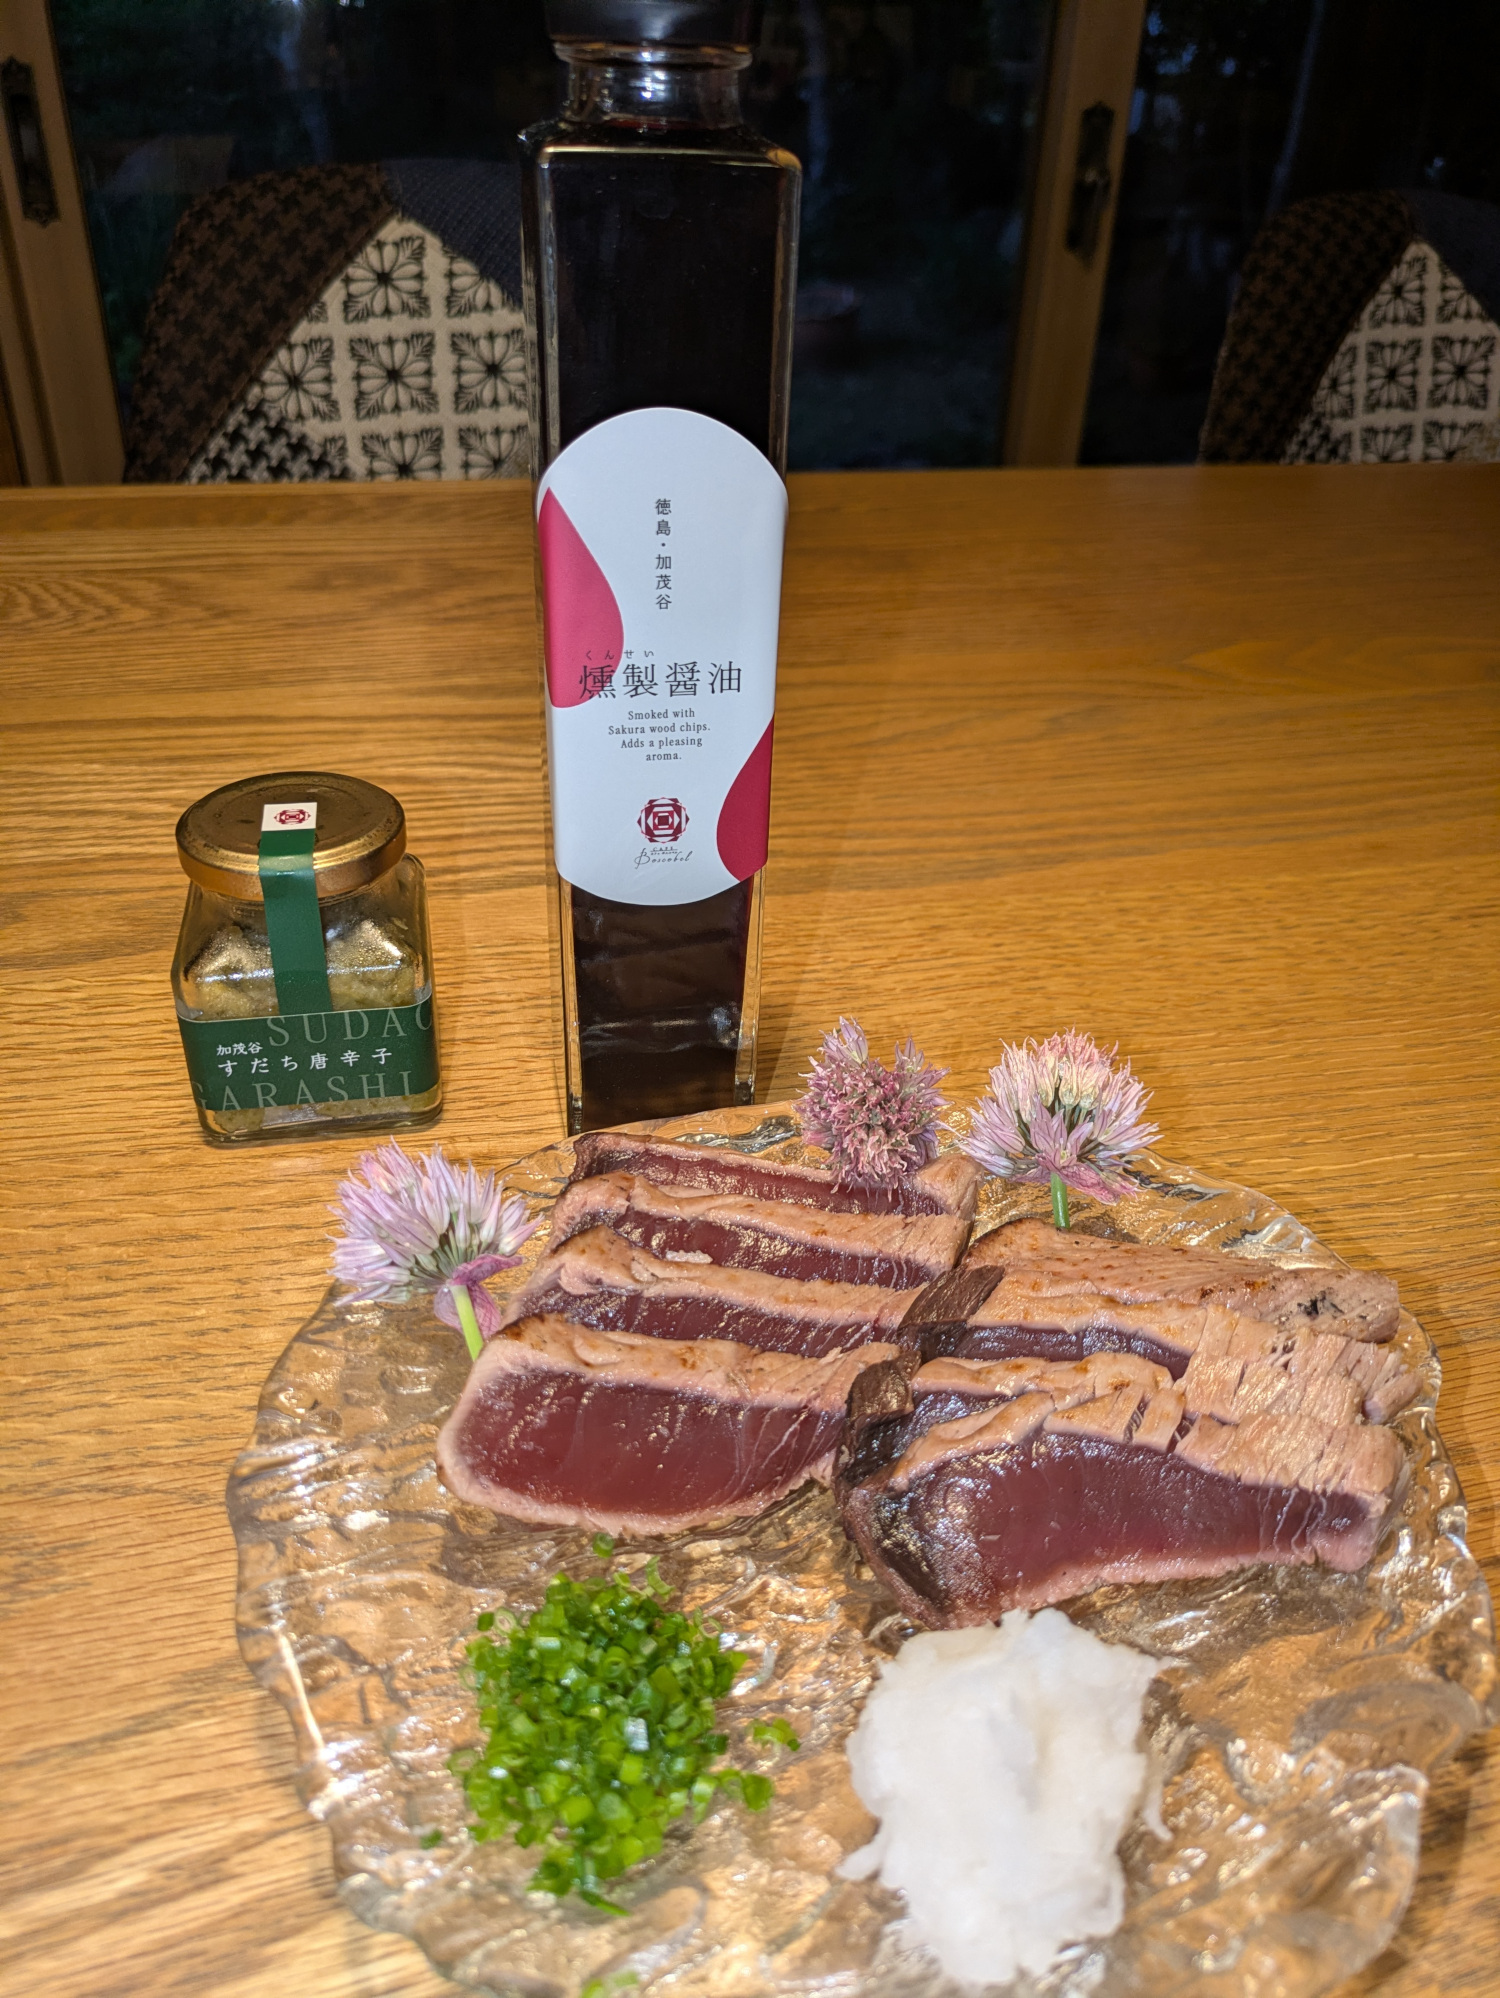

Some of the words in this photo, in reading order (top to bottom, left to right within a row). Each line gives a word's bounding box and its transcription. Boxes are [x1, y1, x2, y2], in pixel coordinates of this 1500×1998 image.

[655, 498, 672, 610] 徳島・加茂谷
[585, 650, 655, 660] くんせい
[579, 661, 742, 699] 燻製醤油
[628, 710, 669, 720] Smoked
[672, 708, 695, 718] with
[608, 725, 645, 735] Sakura
[649, 723, 676, 733] wood
[680, 722, 711, 733] chips.
[621, 739, 645, 749] Adds
[658, 736, 703, 748] pleasing
[646, 752, 682, 762] aroma.
[216, 1041, 264, 1057] 加茂谷
[217, 1047, 393, 1078] すだち唐辛子
